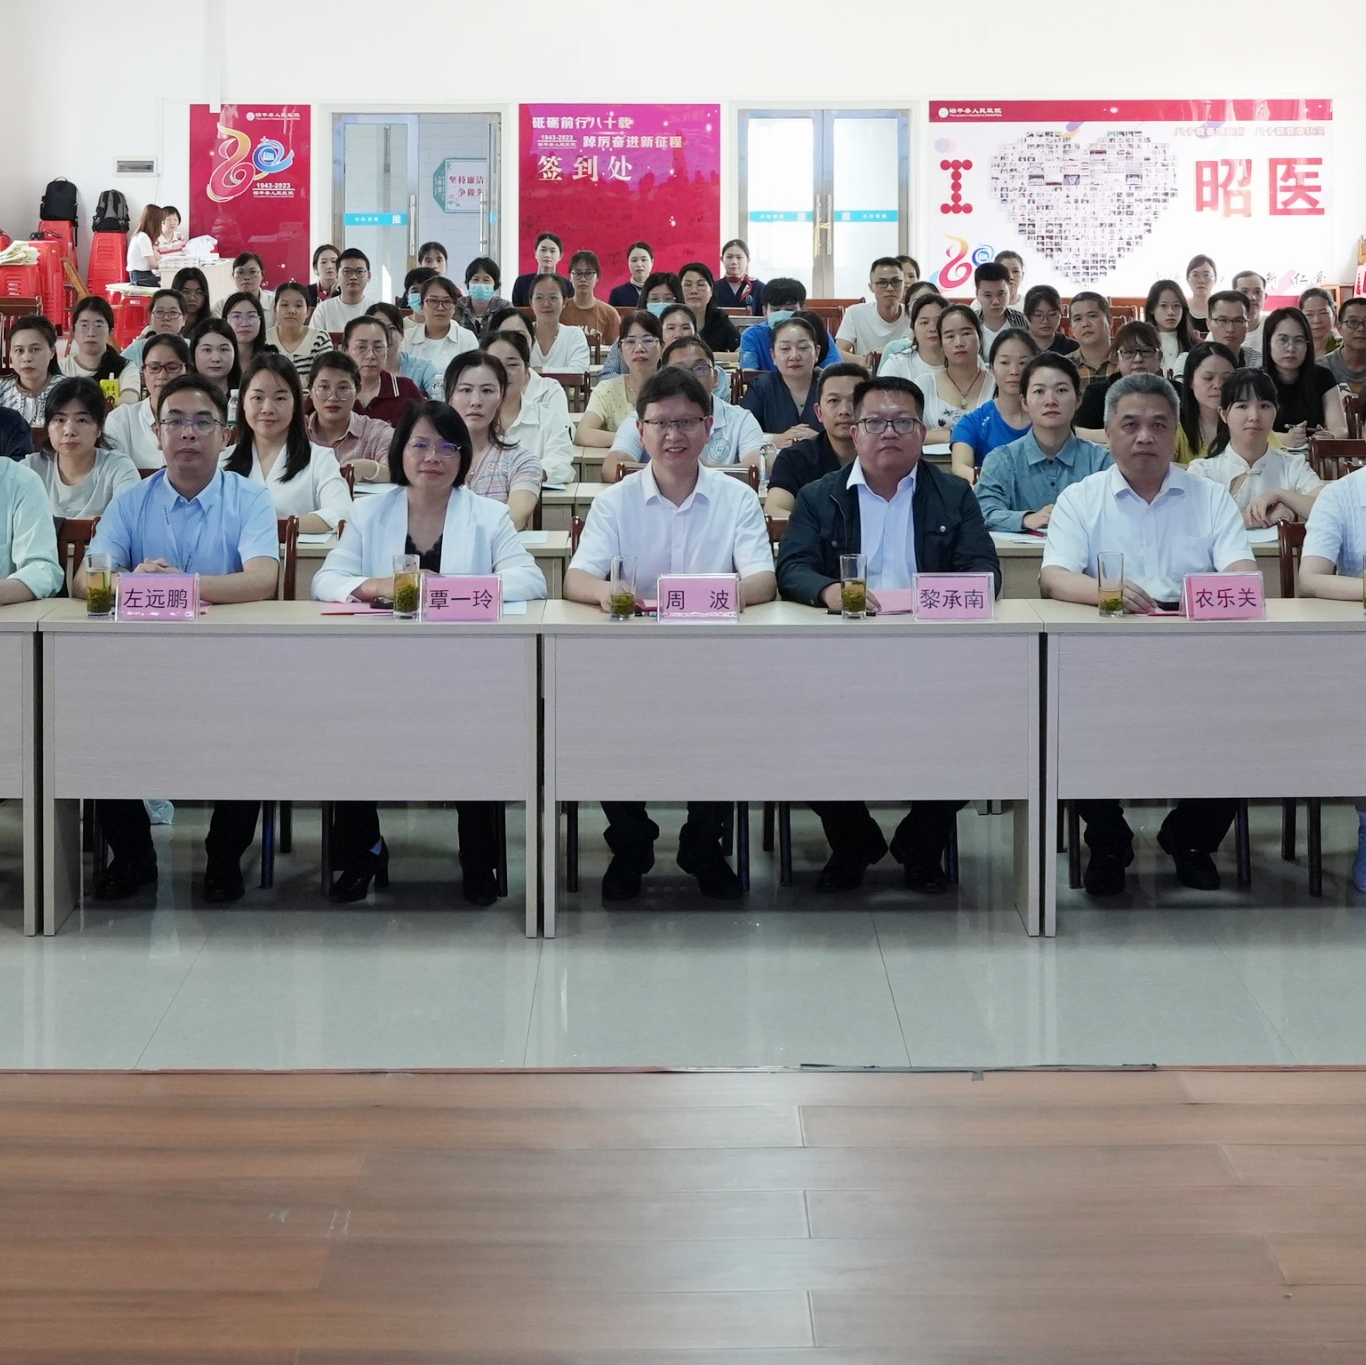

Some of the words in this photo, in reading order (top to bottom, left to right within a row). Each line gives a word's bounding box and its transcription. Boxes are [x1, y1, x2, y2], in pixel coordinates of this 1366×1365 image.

[532, 116, 634, 129] 砥砺前行八十载
[583, 136, 683, 148] 踔厉奋进新征程
[538, 155, 633, 182] 签到处
[1196, 158, 1325, 218] 昭医
[123, 588, 188, 609] 左远鹏
[429, 589, 494, 610] 覃一玲
[666, 589, 731, 610] 周波
[920, 589, 984, 609] 黎承南
[1195, 588, 1257, 609] 农乐关
